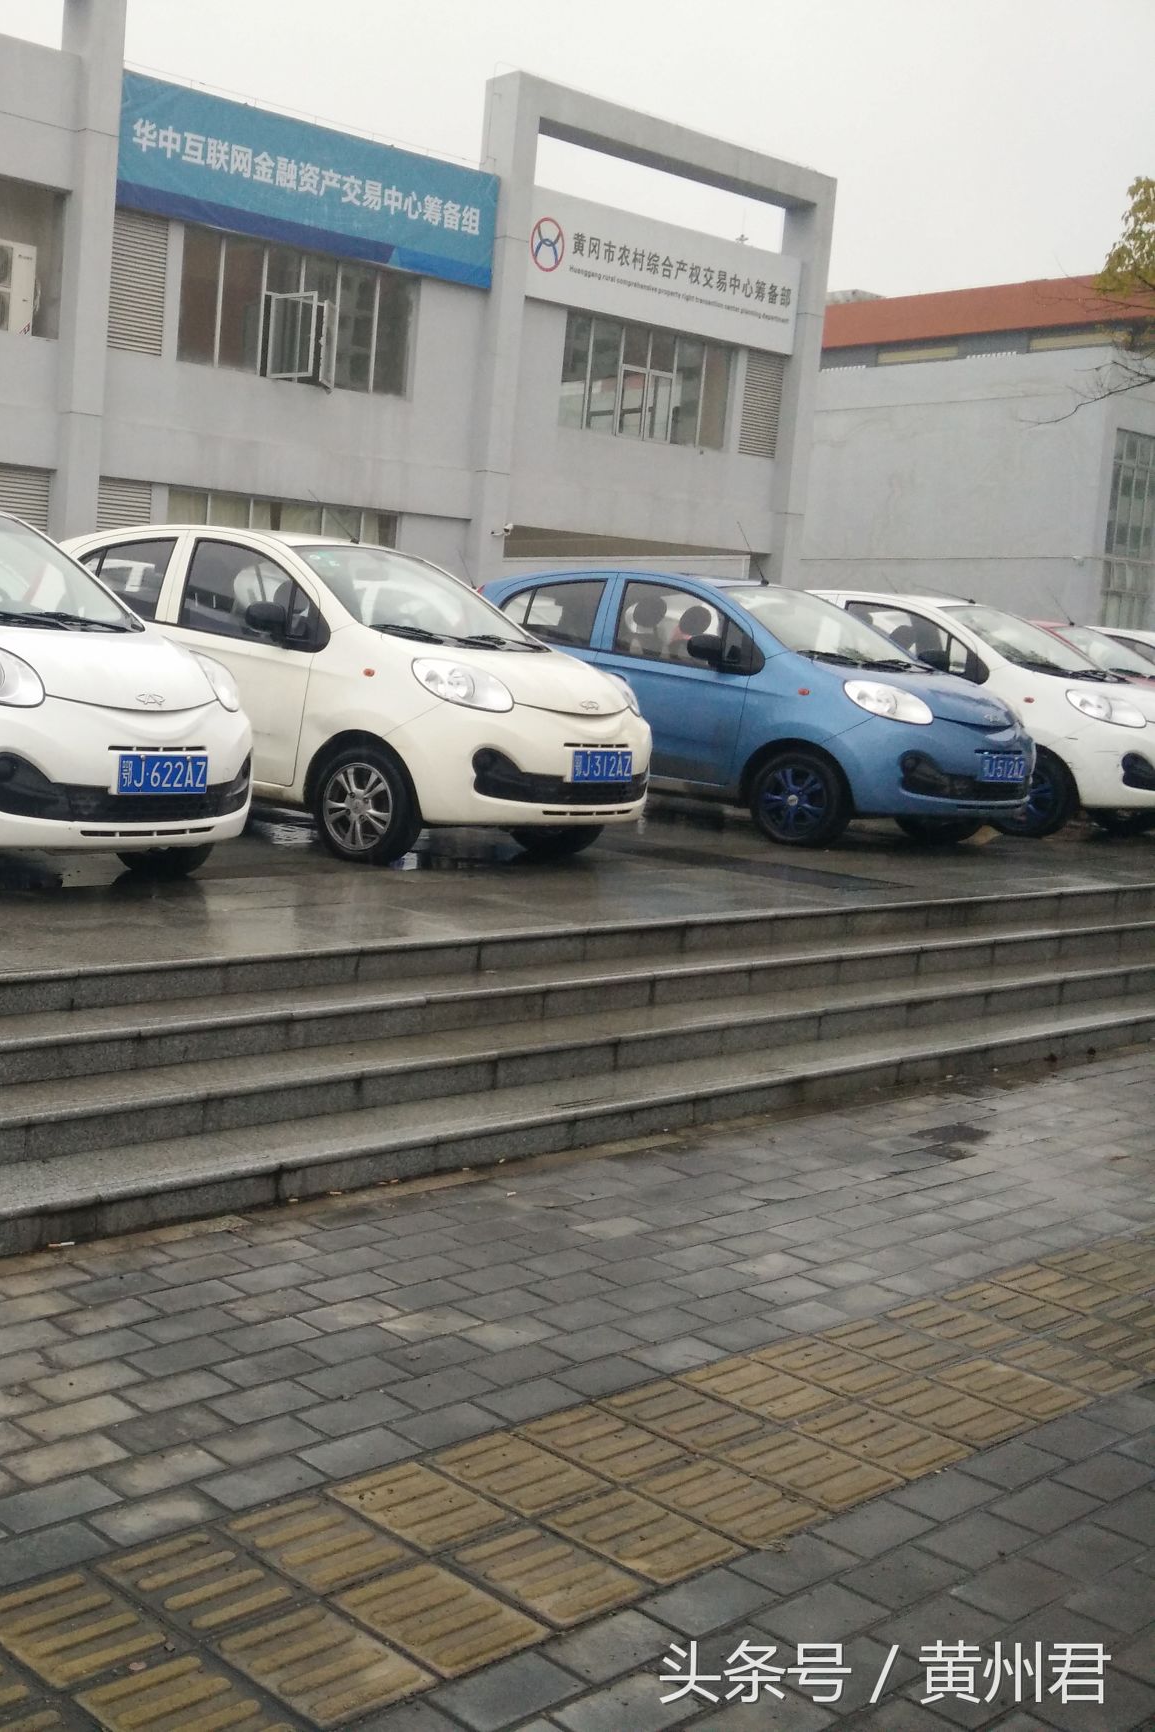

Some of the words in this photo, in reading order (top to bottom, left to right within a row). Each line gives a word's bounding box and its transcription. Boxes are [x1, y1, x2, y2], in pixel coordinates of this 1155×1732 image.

[132, 118, 481, 236] 华中互联网金融资产交易中心筹备组
[572, 232, 792, 308] 黄冈市农村综合产权交易中心筹备部
